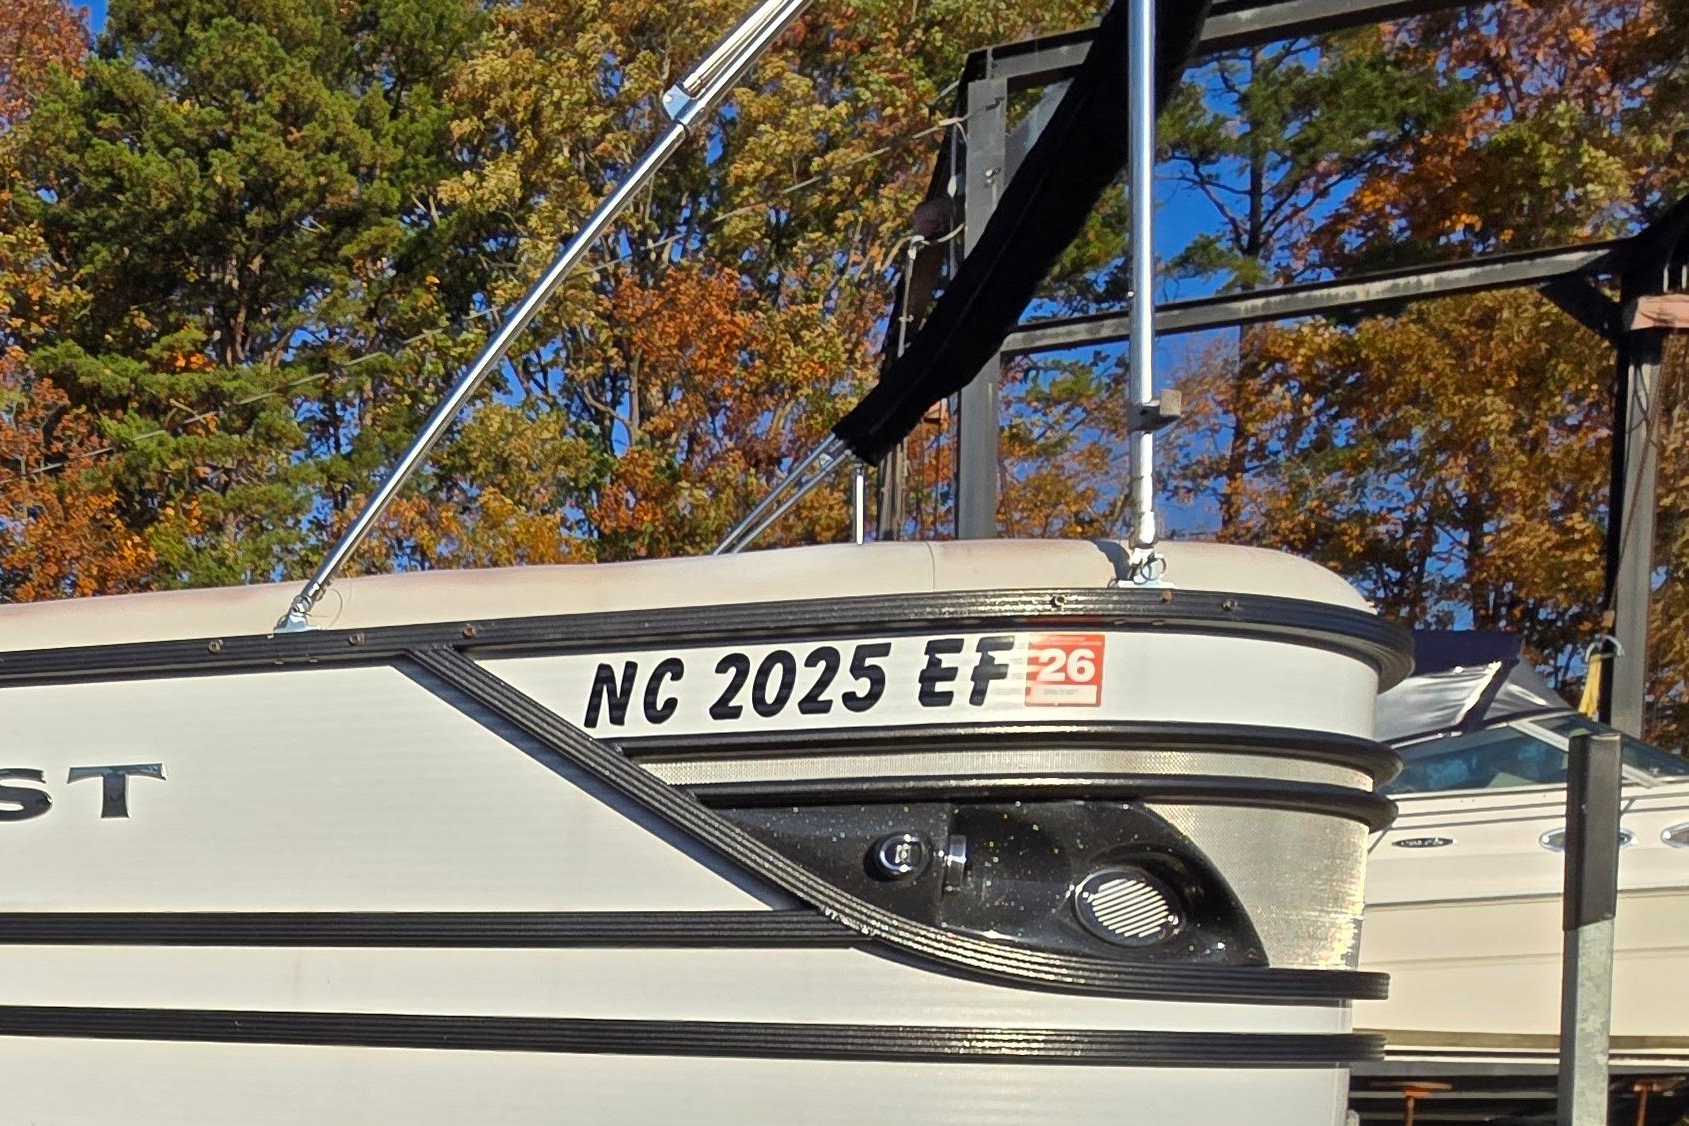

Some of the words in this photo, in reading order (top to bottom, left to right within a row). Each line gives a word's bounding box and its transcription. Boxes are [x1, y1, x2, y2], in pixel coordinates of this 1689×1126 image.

[584, 657, 685, 728] NC
[709, 642, 891, 720] 2025
[918, 636, 1015, 707] EF
[1037, 648, 1096, 682] 26
